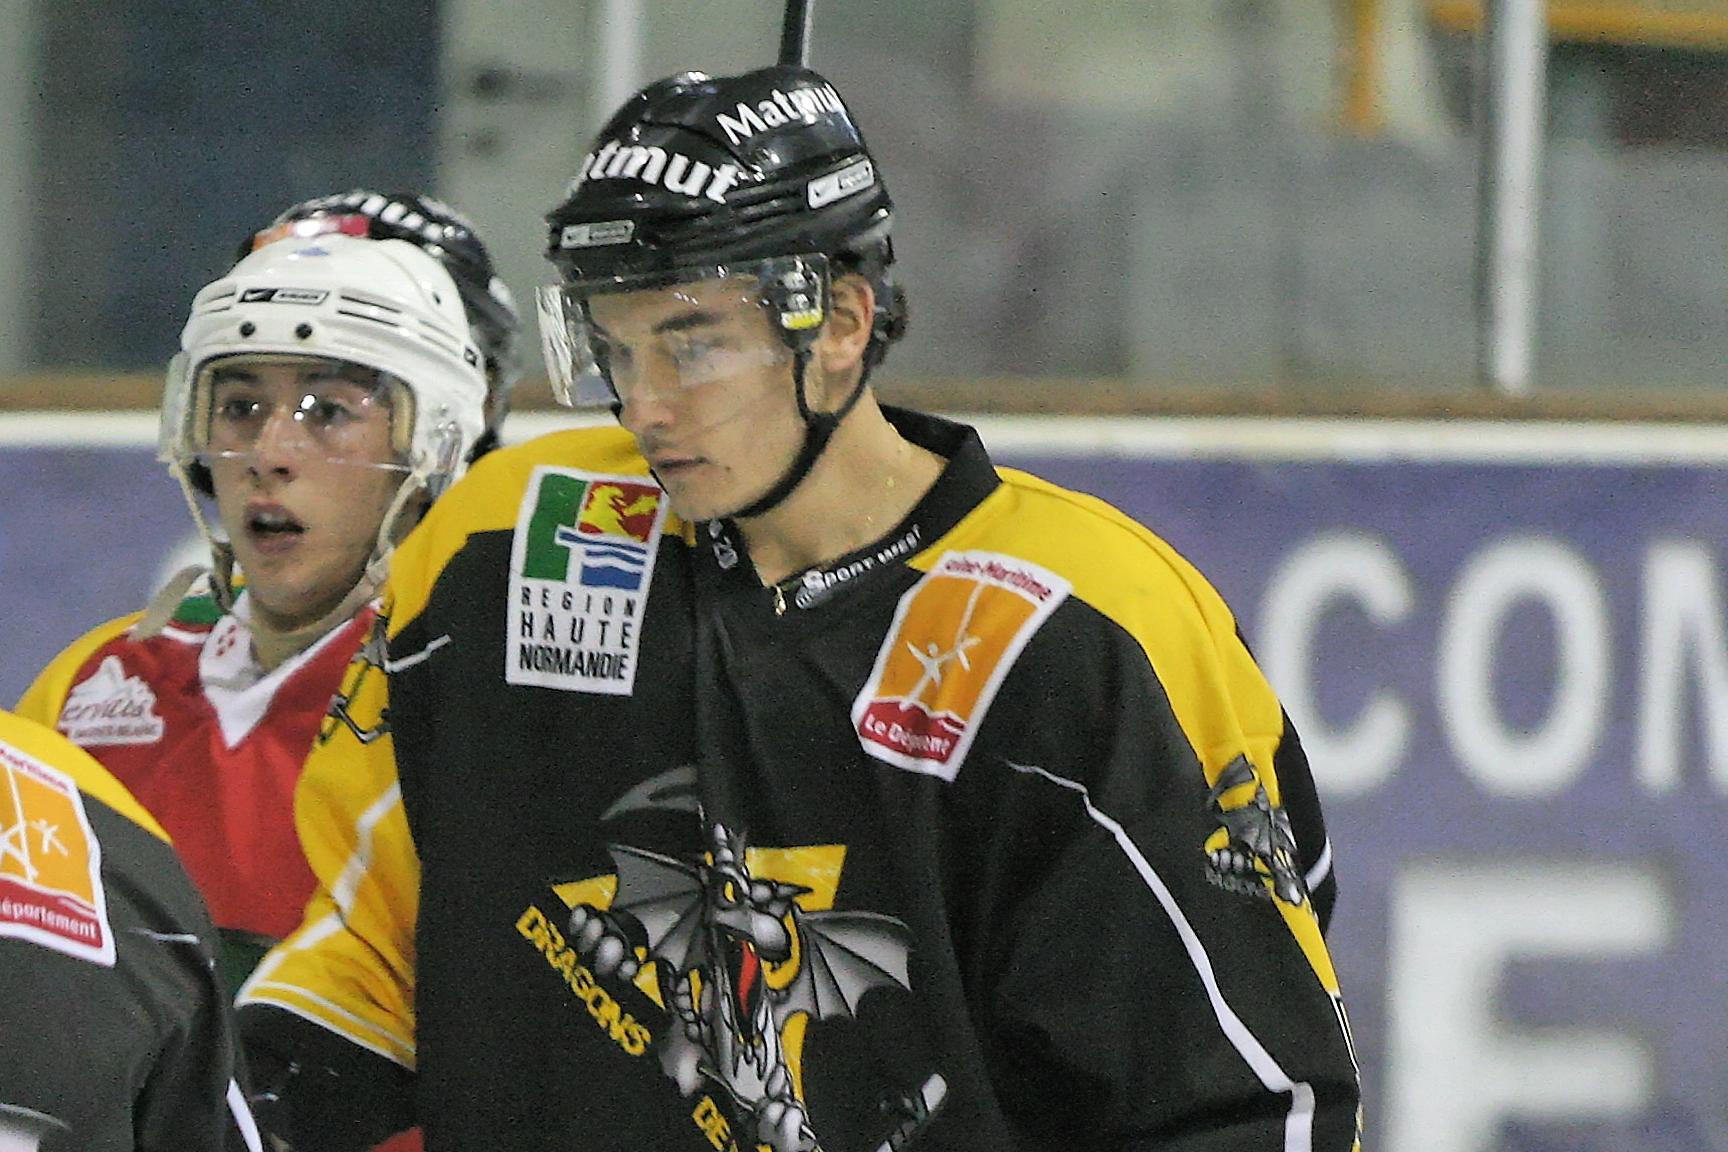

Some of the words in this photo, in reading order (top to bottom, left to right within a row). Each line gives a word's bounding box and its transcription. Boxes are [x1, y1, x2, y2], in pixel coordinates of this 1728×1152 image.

[583, 139, 739, 204] tmut
[521, 610, 633, 649] HAUTE
[519, 642, 629, 680] NORMANDIE
[515, 905, 652, 1057] DRAGONS
